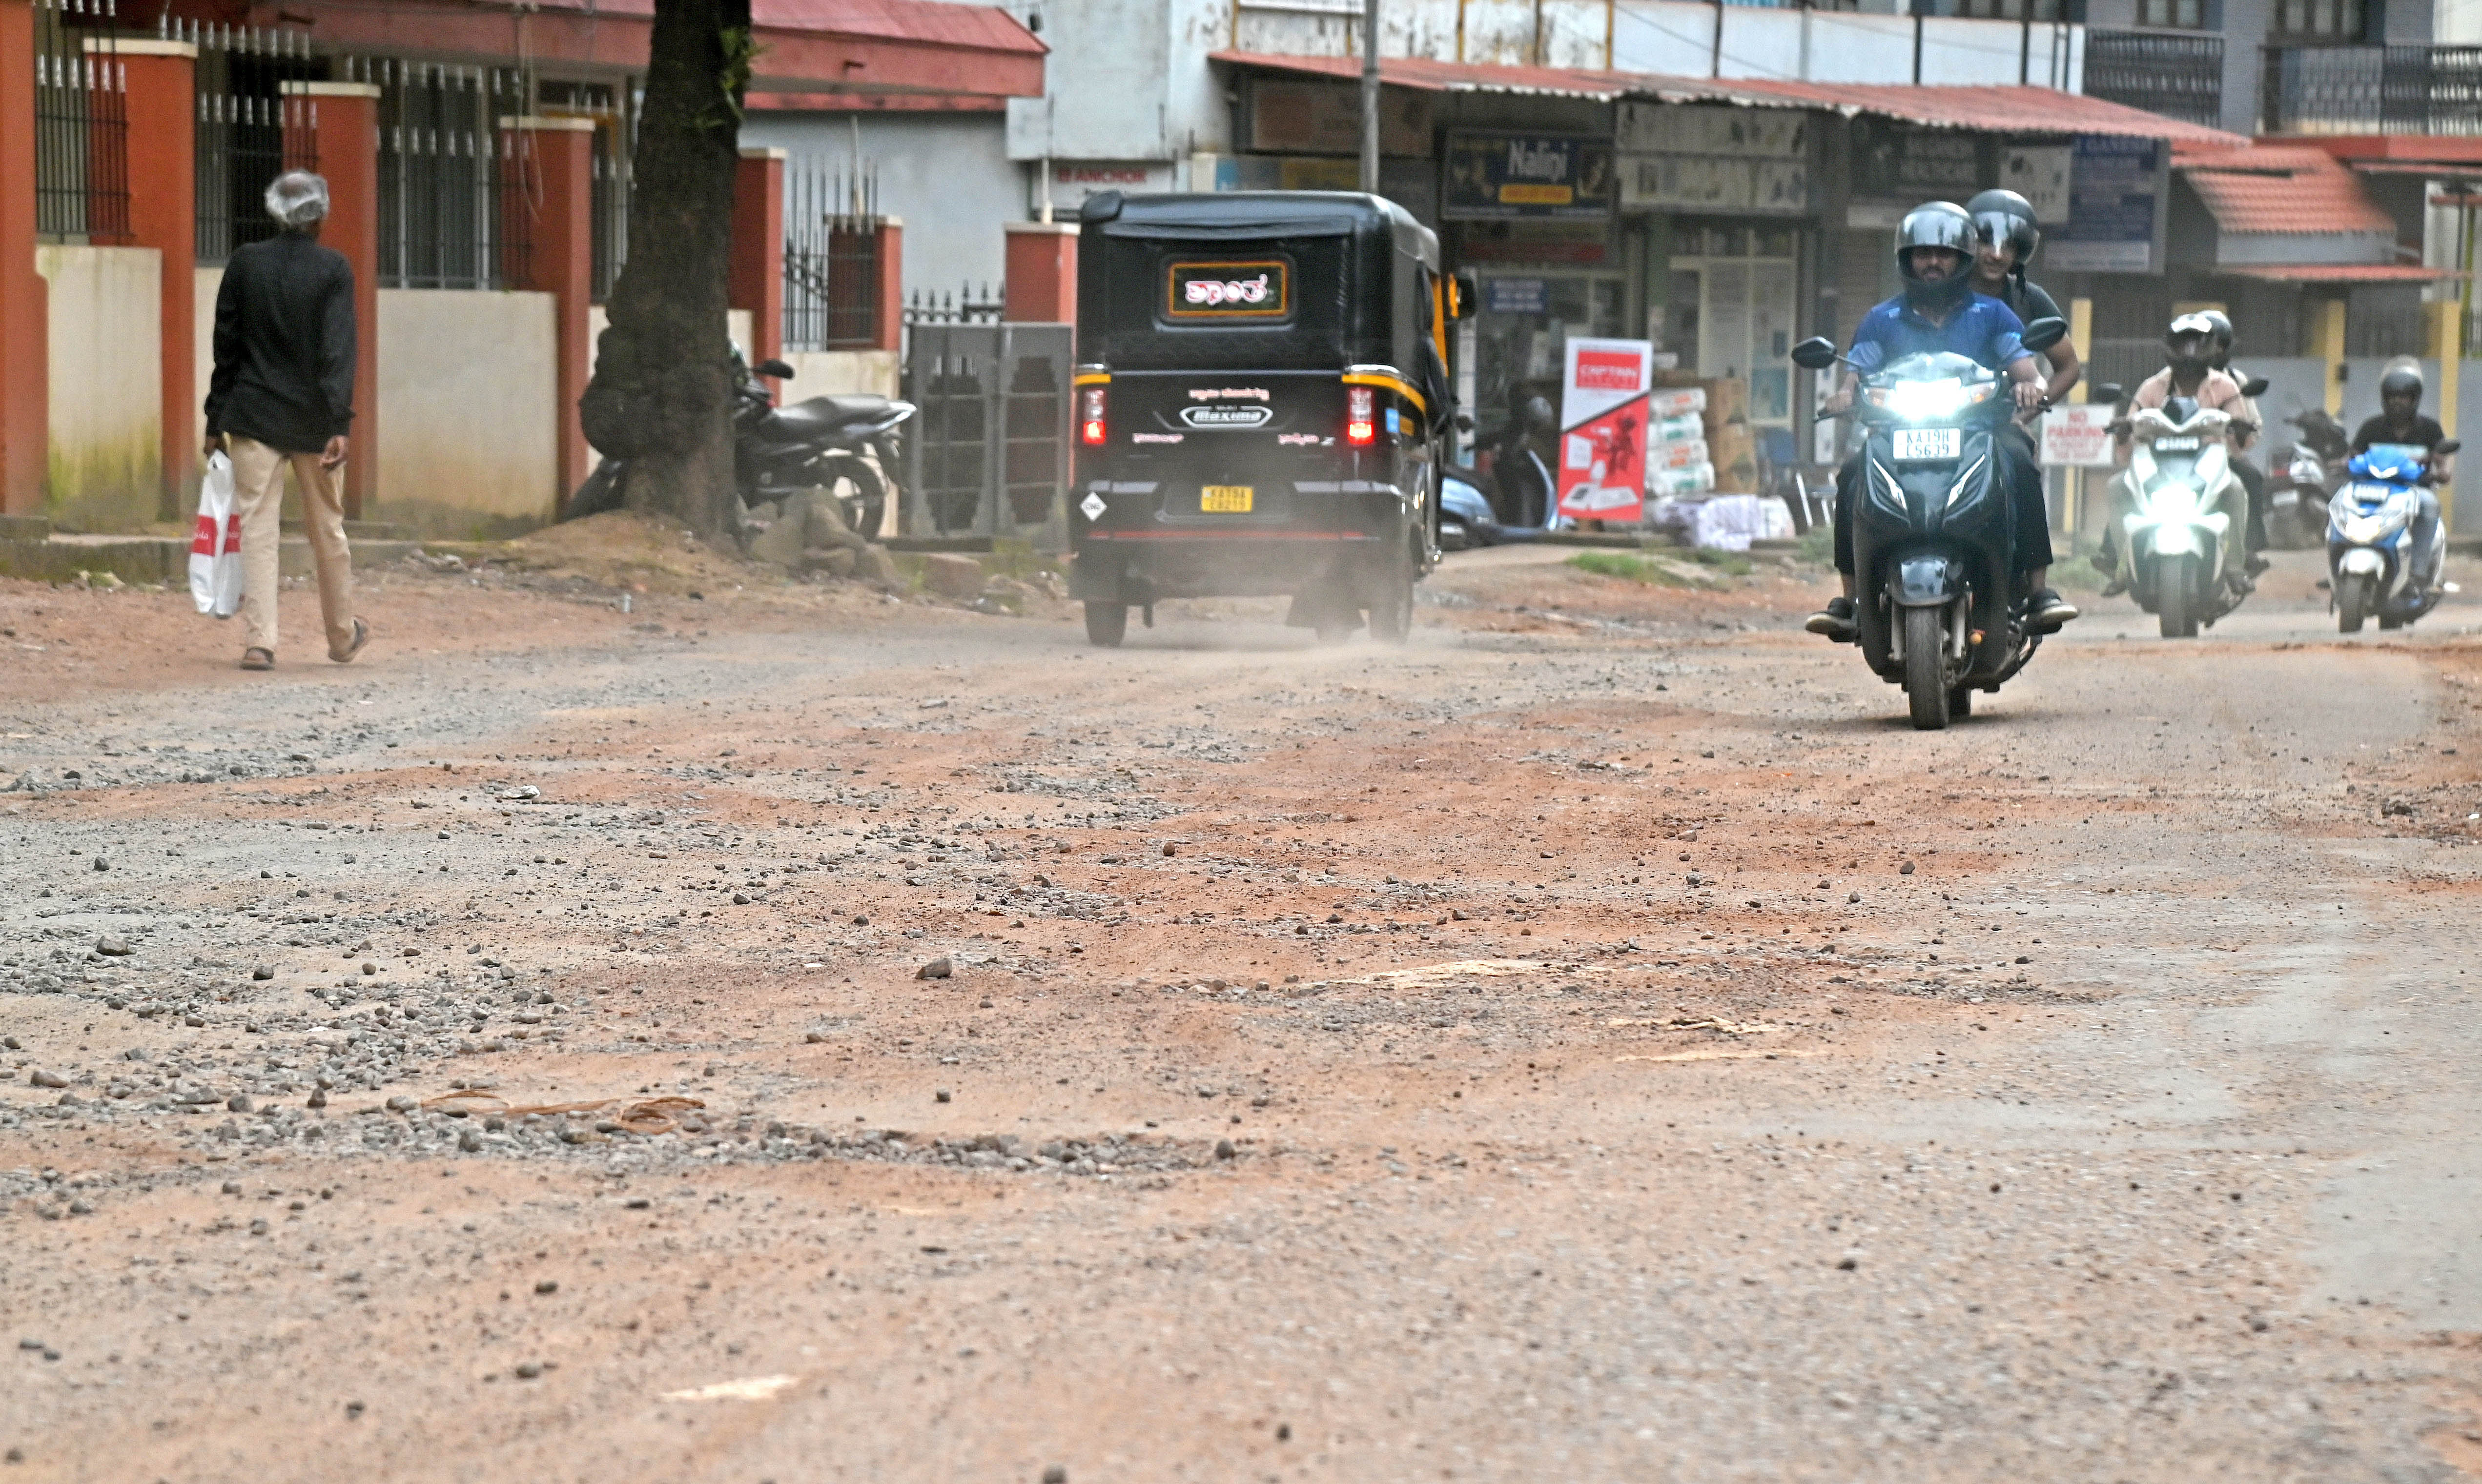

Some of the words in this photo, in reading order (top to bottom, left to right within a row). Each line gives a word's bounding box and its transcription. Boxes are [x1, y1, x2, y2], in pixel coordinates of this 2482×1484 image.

[1193, 410, 1262, 421] Maxima
[2069, 412, 2088, 422] NO
[1906, 430, 1949, 443] KA19H
